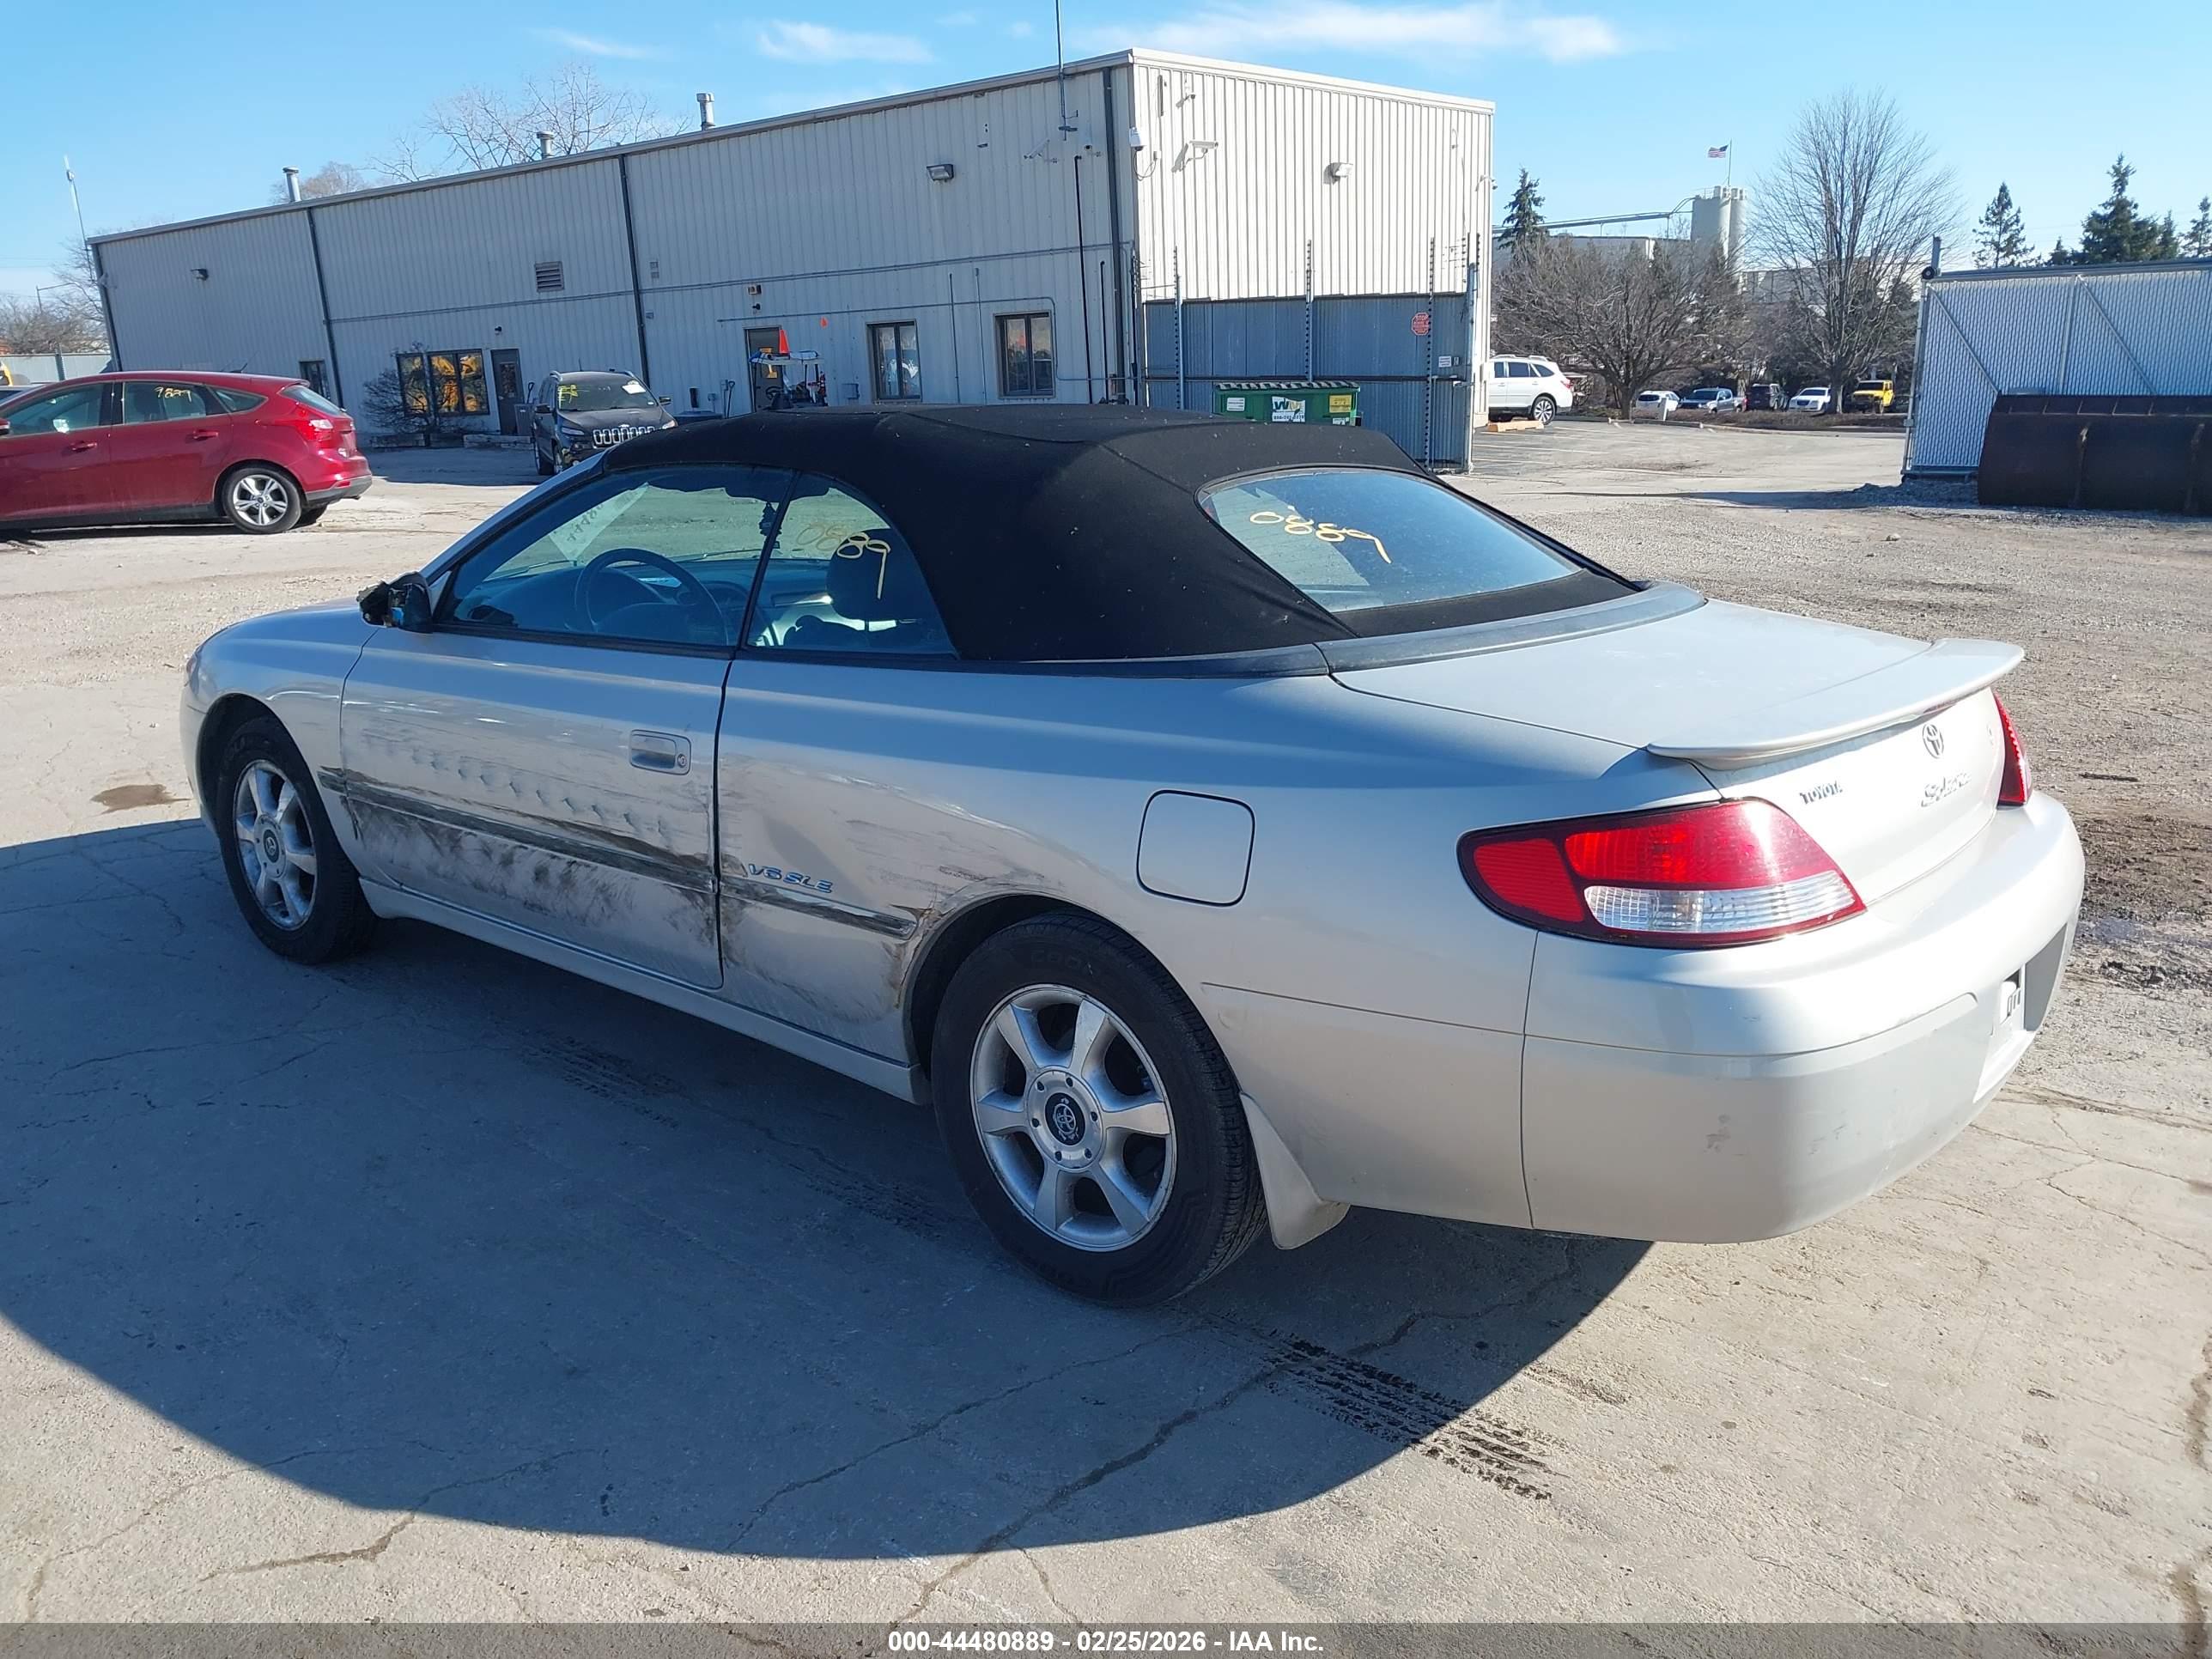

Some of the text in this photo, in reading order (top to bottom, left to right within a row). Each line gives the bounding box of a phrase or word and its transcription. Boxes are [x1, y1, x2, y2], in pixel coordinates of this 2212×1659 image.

[1249, 506, 1392, 564] 0889
[748, 863, 834, 894] V6 SLE
